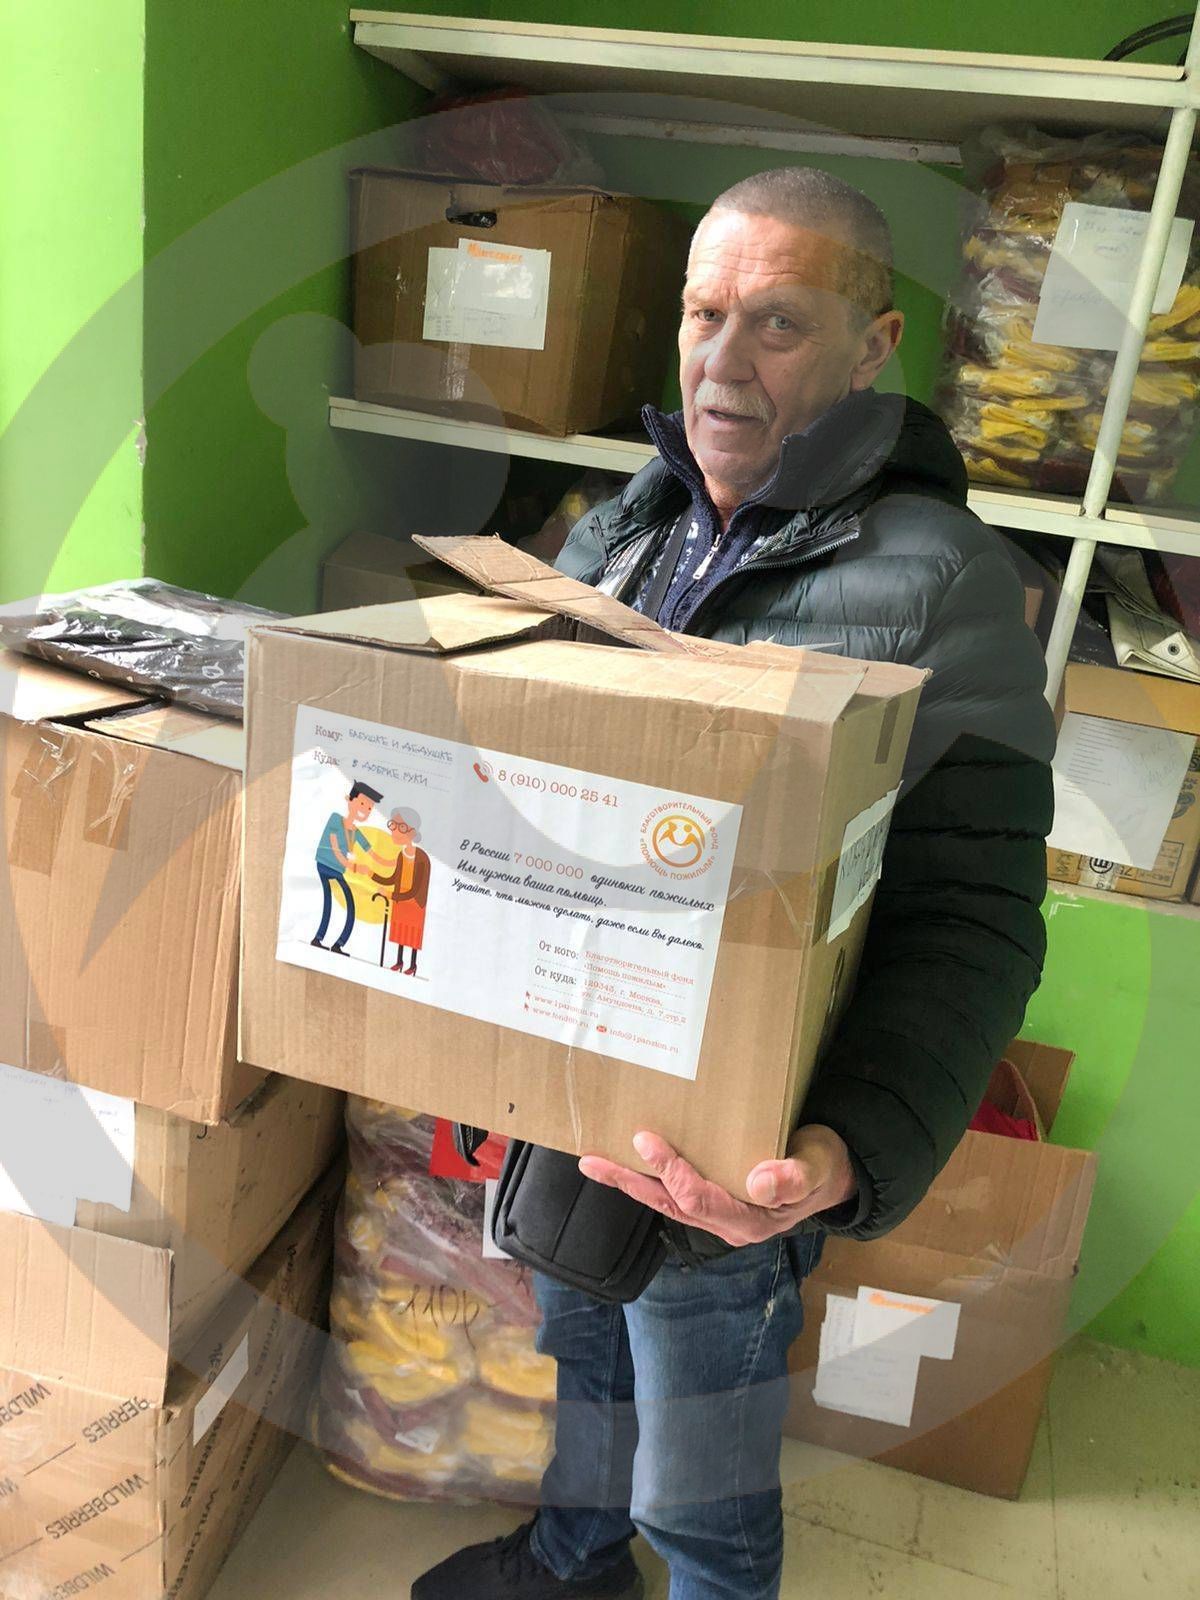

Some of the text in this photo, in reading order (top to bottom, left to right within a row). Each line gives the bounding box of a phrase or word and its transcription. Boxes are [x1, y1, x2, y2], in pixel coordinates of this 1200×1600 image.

[314, 724, 343, 742] Кому:
[392, 739, 399, 749] И
[313, 750, 340, 766] Куда:
[498, 769, 619, 808] 8 (910) 000 25 41
[640, 802, 719, 850] БЛАГОТВОРИТЕЛЬНЫЙ ФОНД
[457, 859, 607, 907] Им нужна ваша помощь.
[460, 839, 715, 912] В России 7 000 000 одиноких пожилых
[494, 891, 514, 902] что
[515, 896, 551, 911] можно
[596, 916, 626, 931] даже
[627, 925, 650, 936] если
[651, 928, 666, 940] Вы
[539, 940, 580, 960] От кого:
[534, 965, 577, 985] От куда:
[0, 1383, 51, 1428] WILDB
[45, 1473, 149, 1540] WILDBERRIES
